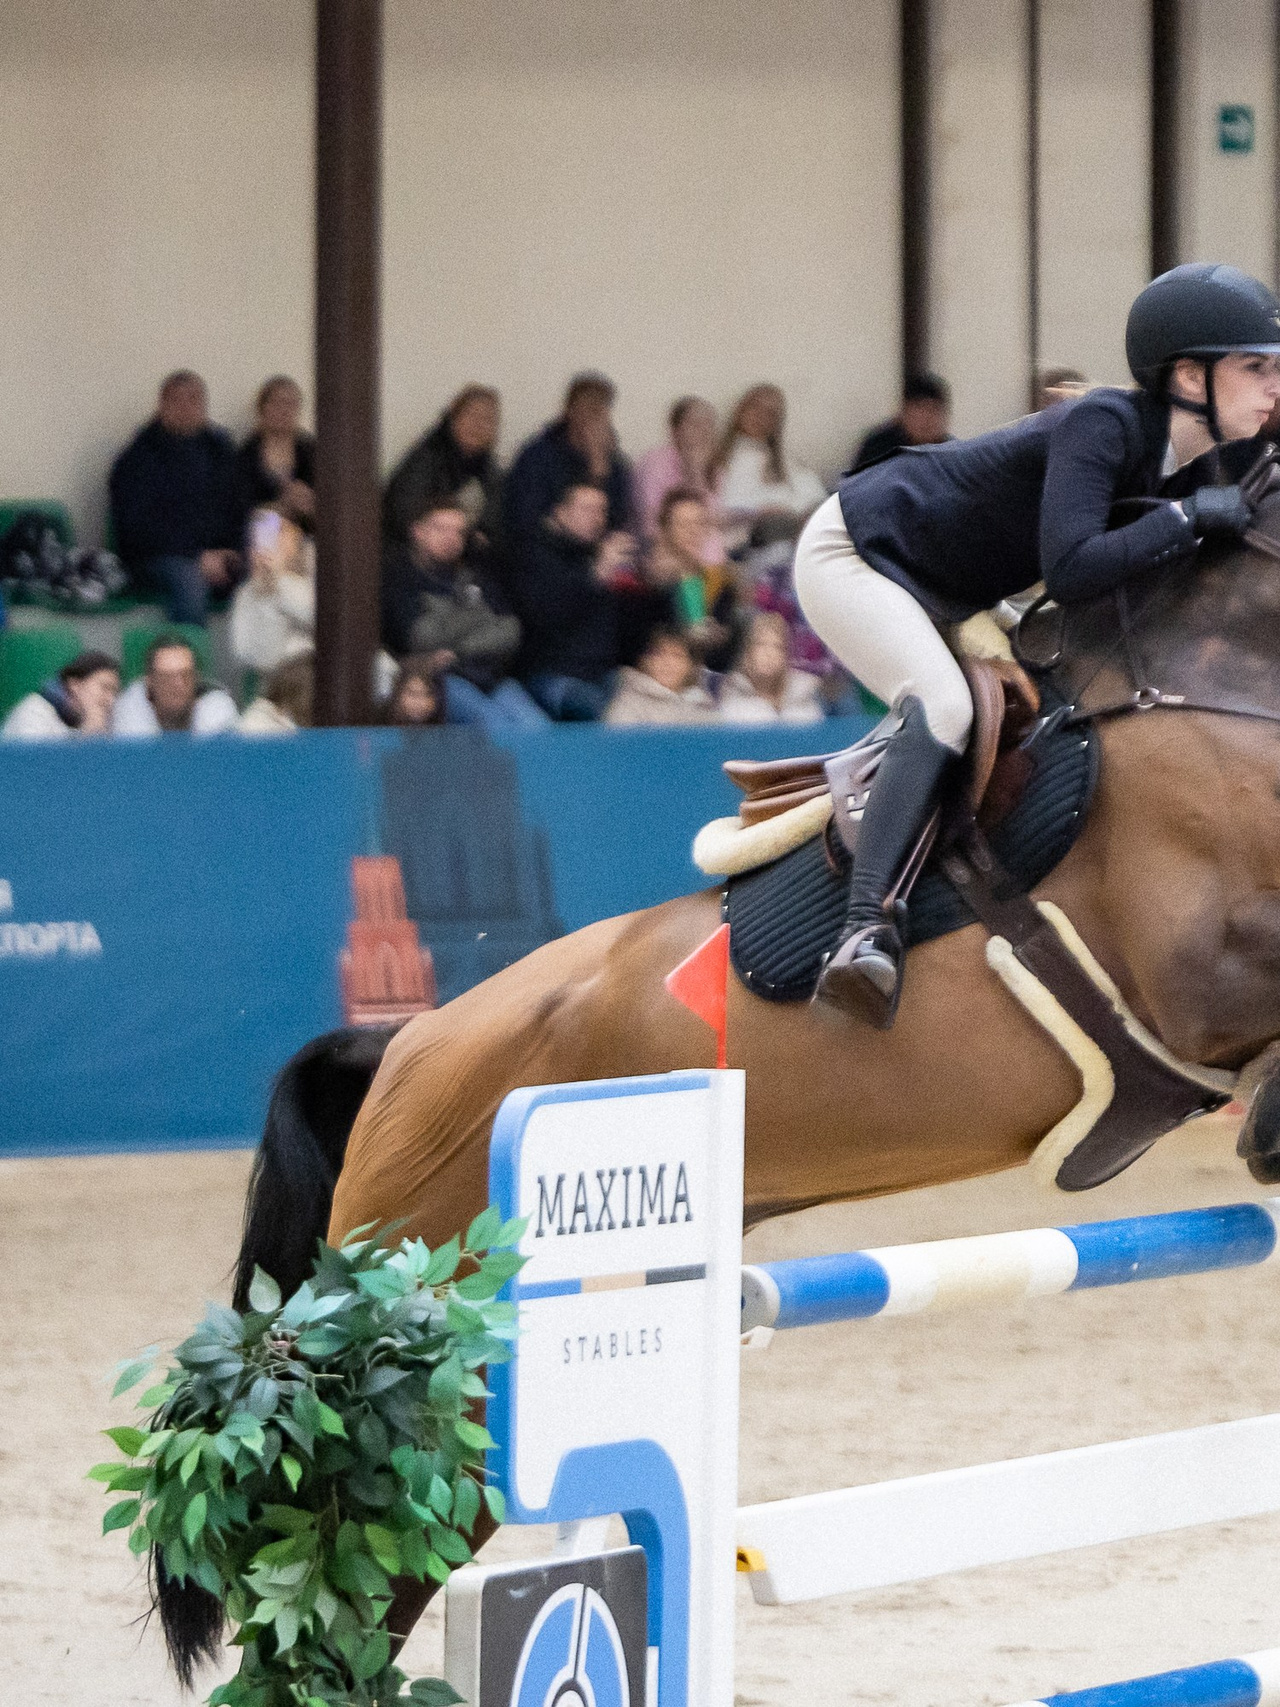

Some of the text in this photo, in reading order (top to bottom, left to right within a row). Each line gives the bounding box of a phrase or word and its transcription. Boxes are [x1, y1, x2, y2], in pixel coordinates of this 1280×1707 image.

[0, 921, 102, 953] ПОРТА
[535, 1161, 694, 1238] MAXIMA
[563, 1327, 663, 1364] STABLES
